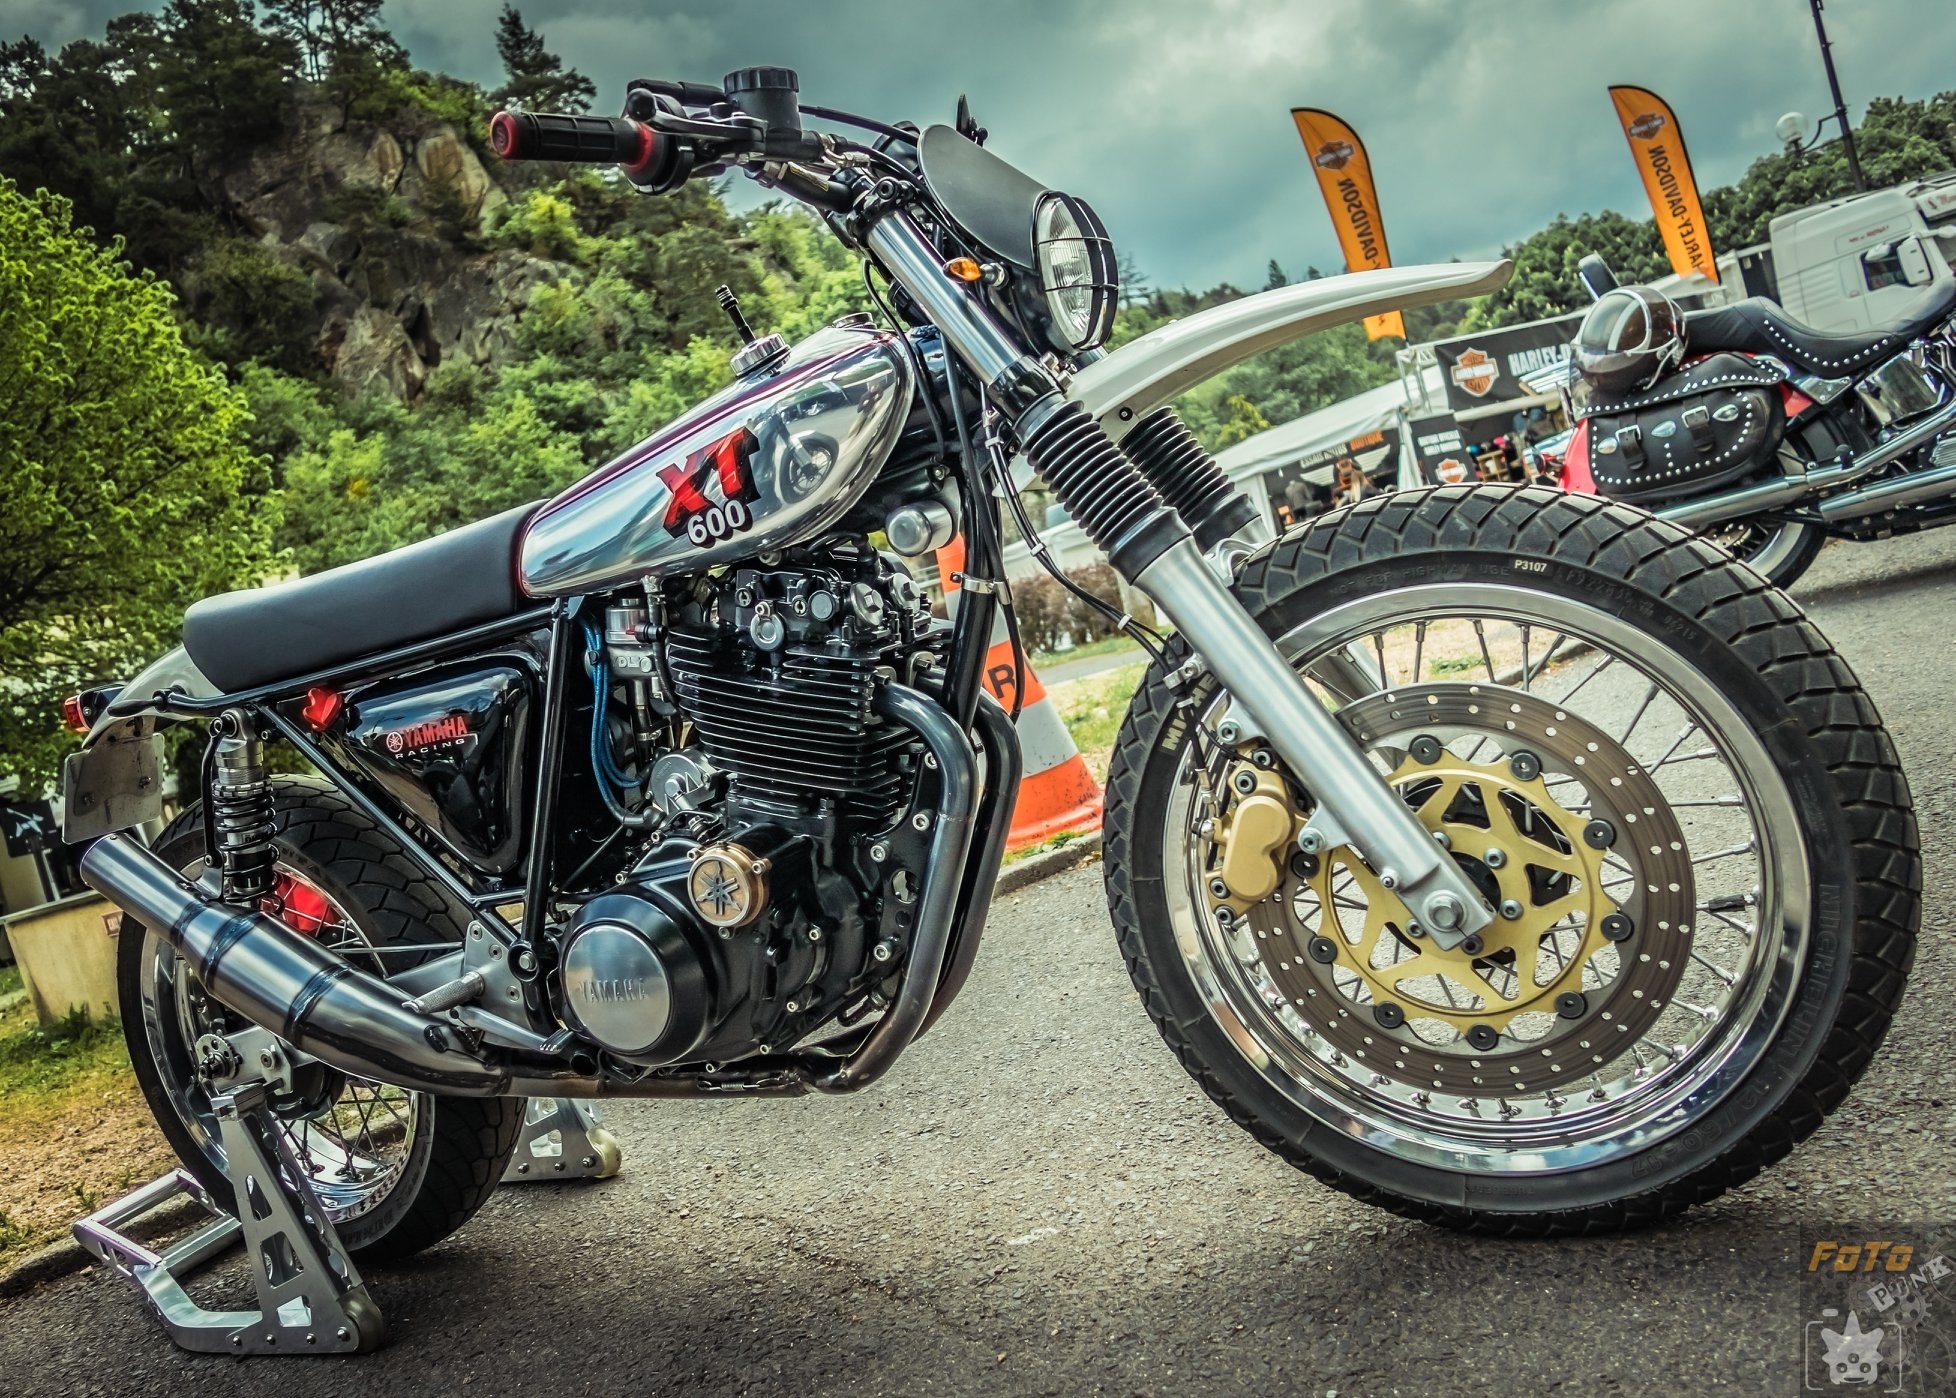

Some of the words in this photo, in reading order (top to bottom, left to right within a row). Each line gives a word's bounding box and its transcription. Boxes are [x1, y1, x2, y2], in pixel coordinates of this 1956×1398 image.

[656, 426, 758, 536] XT
[687, 499, 748, 545] 600
[1514, 559, 1547, 573] P3107
[988, 664, 1015, 699] R
[395, 738, 465, 759] RACING
[403, 716, 468, 748] YAMAHA
[1781, 883, 1841, 1057] MICHELIN
[577, 978, 649, 1003] YAMAHA
